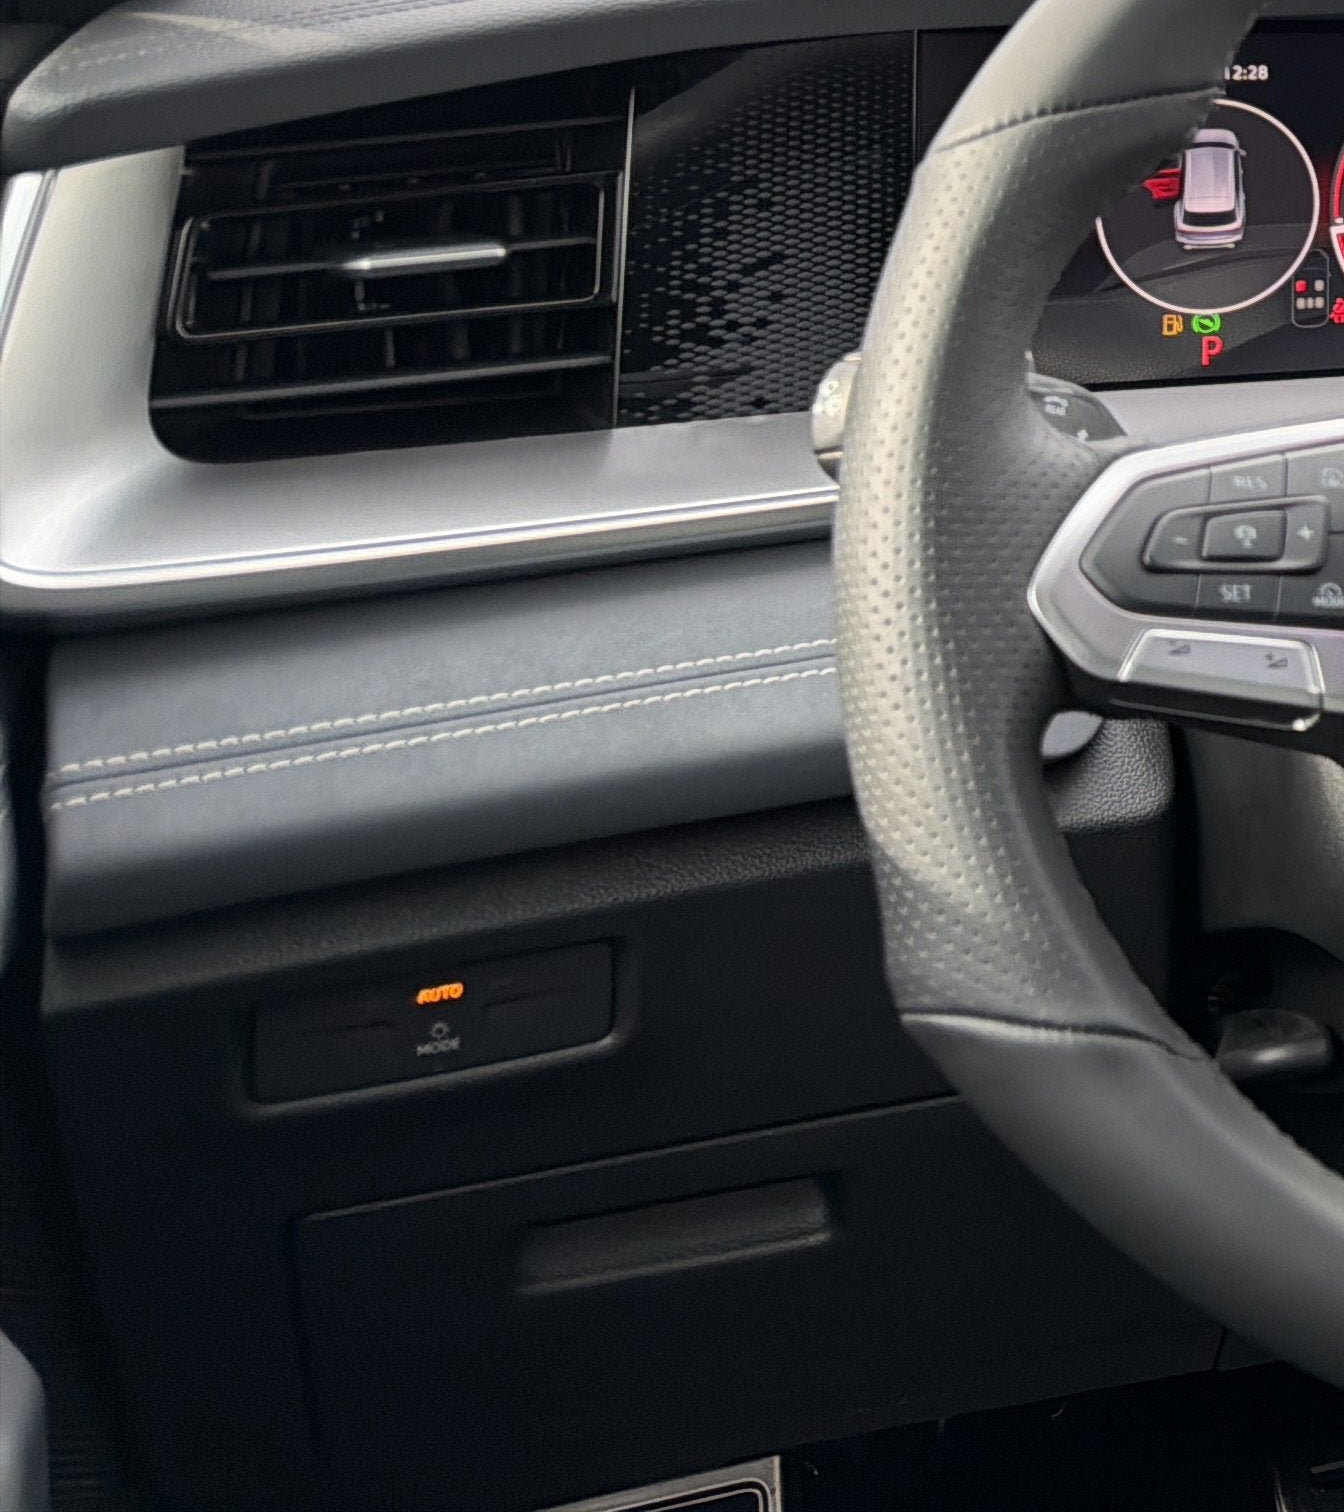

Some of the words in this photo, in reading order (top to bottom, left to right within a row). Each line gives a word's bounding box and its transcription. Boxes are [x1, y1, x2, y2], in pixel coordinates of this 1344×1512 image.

[1201, 336, 1224, 366] P
[1218, 583, 1253, 603] SET
[416, 981, 465, 1006] AUTO
[416, 1036, 461, 1057] MODE
